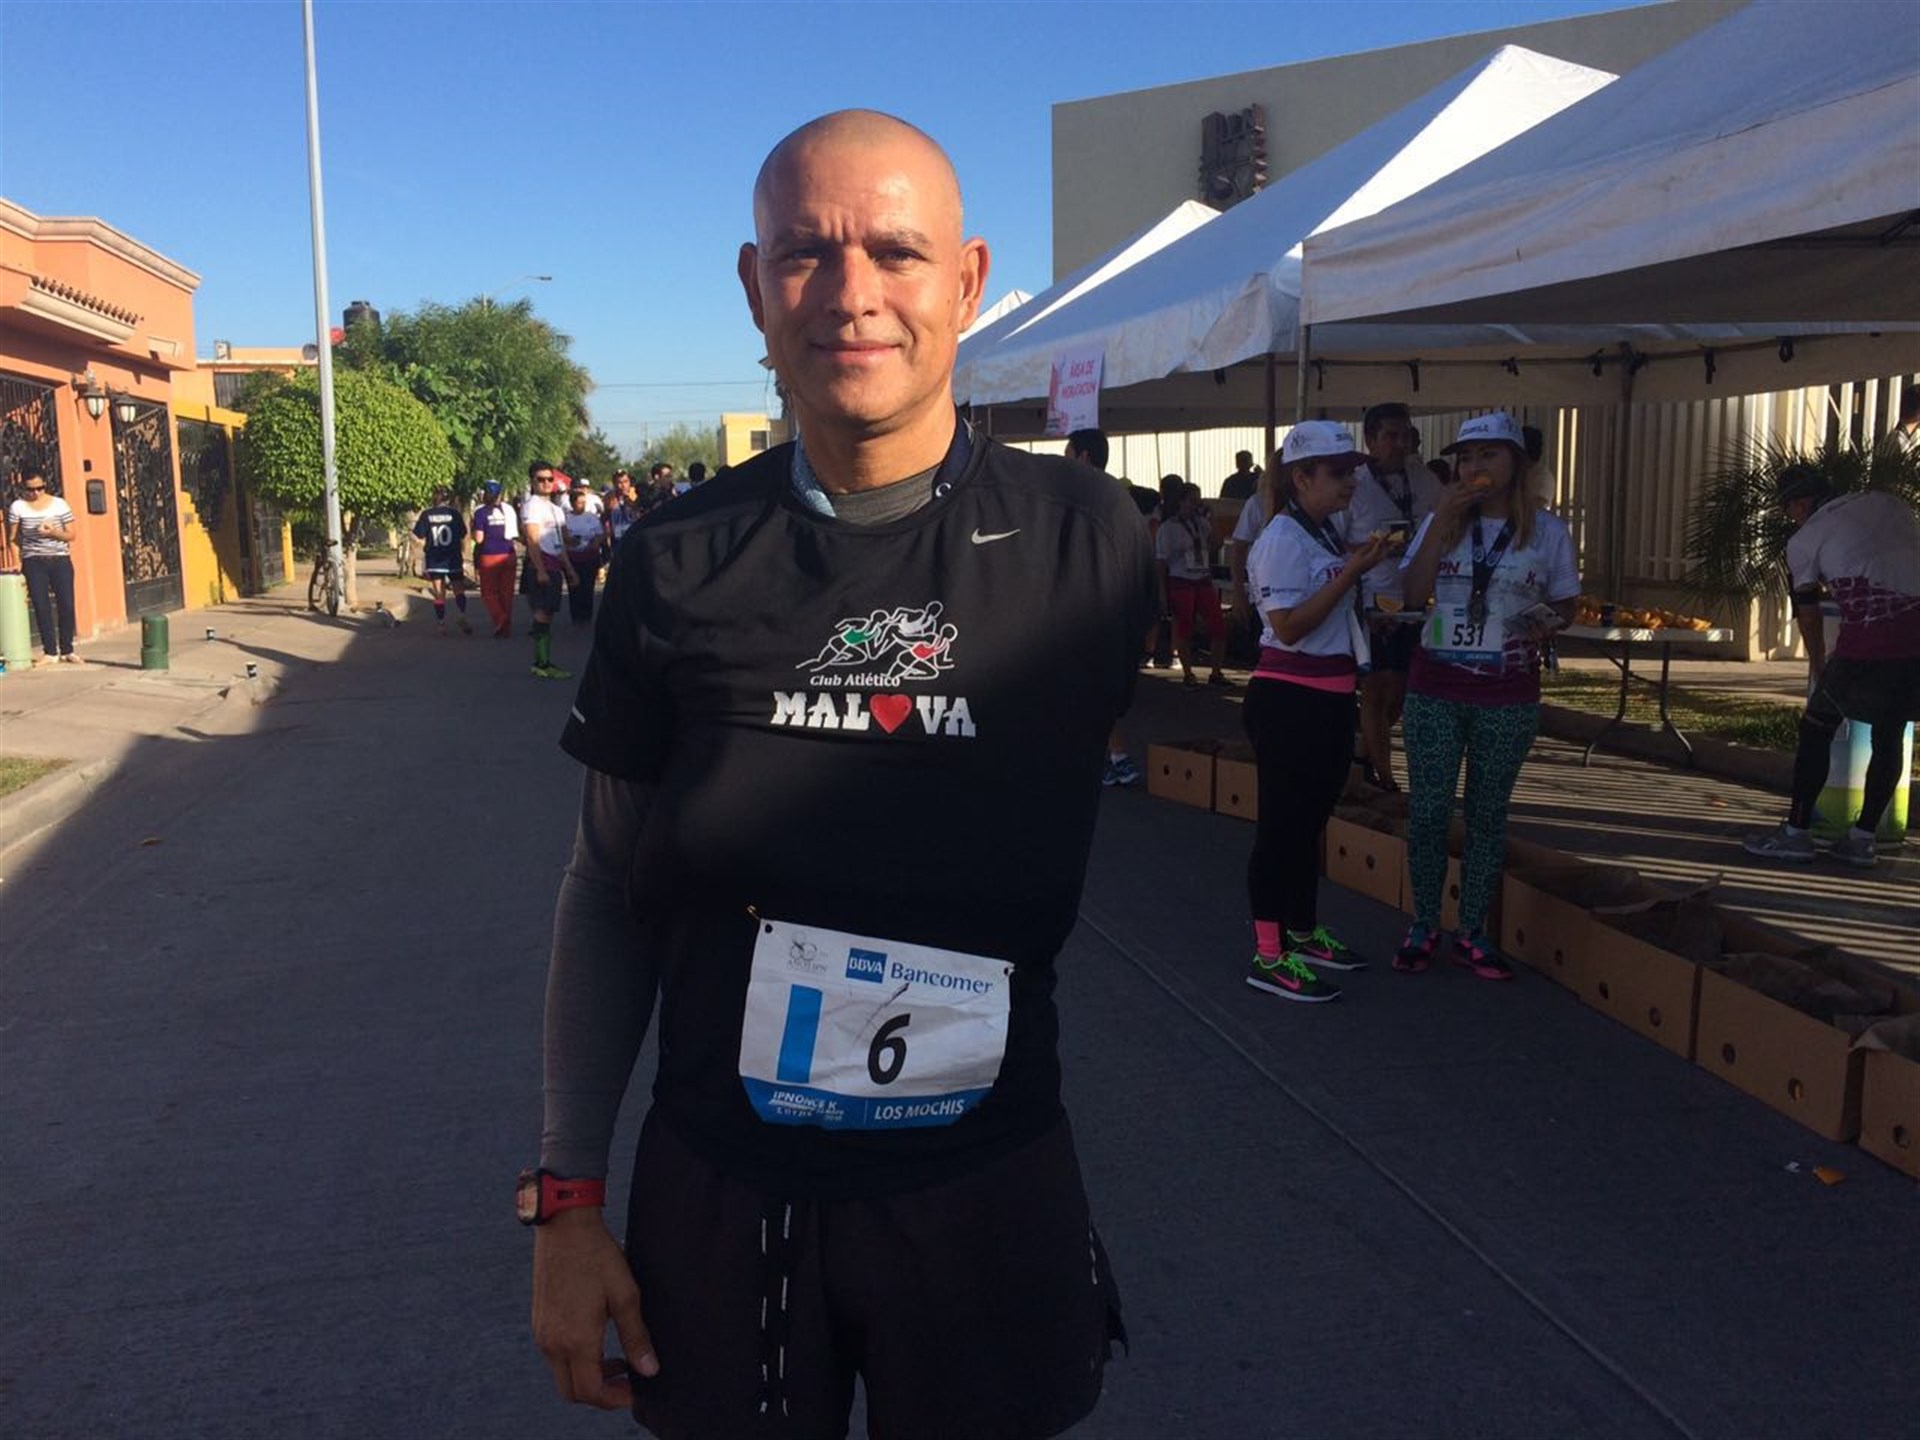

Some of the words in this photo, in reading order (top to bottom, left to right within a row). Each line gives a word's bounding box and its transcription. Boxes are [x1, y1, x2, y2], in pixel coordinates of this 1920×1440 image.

[431, 524, 453, 546] 10
[1451, 623, 1486, 647] 531
[809, 674, 842, 686] Club
[844, 672, 901, 687] Atlético
[848, 956, 883, 974] BBVA
[890, 961, 994, 995] Bancomer
[867, 1013, 911, 1086] 6
[874, 1104, 904, 1121] LOS
[904, 1098, 965, 1119] MOCHIS
